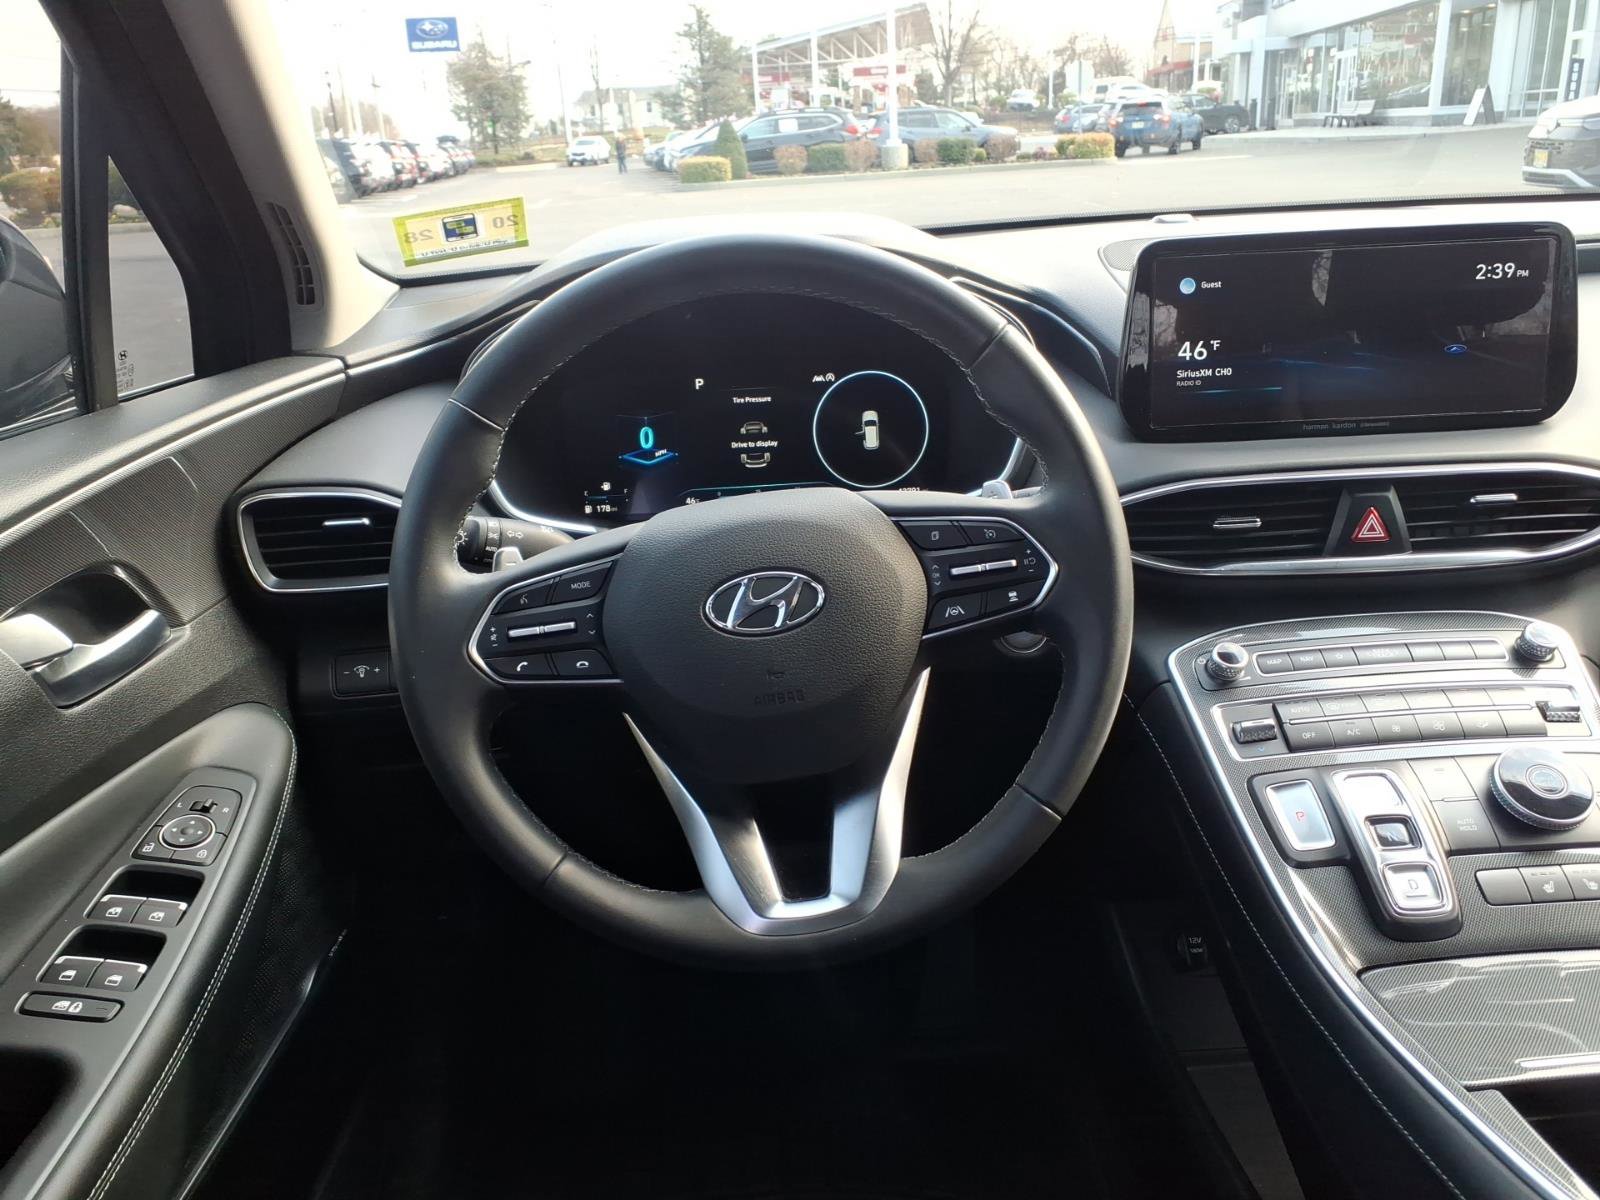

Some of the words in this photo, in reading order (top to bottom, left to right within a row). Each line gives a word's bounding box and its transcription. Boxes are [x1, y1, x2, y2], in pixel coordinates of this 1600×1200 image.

[411, 40, 458, 50] SUBARU
[1475, 262, 1516, 280] 2:39
[1516, 269, 1529, 278] PM
[1201, 281, 1222, 289] Guest
[1178, 340, 1208, 361] 46
[1176, 368, 1212, 378] SiriusXM
[695, 378, 704, 390] P
[640, 426, 654, 449] 0
[731, 441, 748, 449] Drive
[748, 440, 755, 448] to
[755, 440, 778, 448] display
[596, 504, 612, 513] 178
[485, 545, 498, 553] AUTO
[570, 580, 592, 590] MODE
[753, 688, 806, 706] AIRBAG
[1302, 732, 1316, 740] OFF
[1346, 728, 1361, 736] A/C
[1295, 811, 1305, 821] P
[1407, 878, 1420, 891] D
